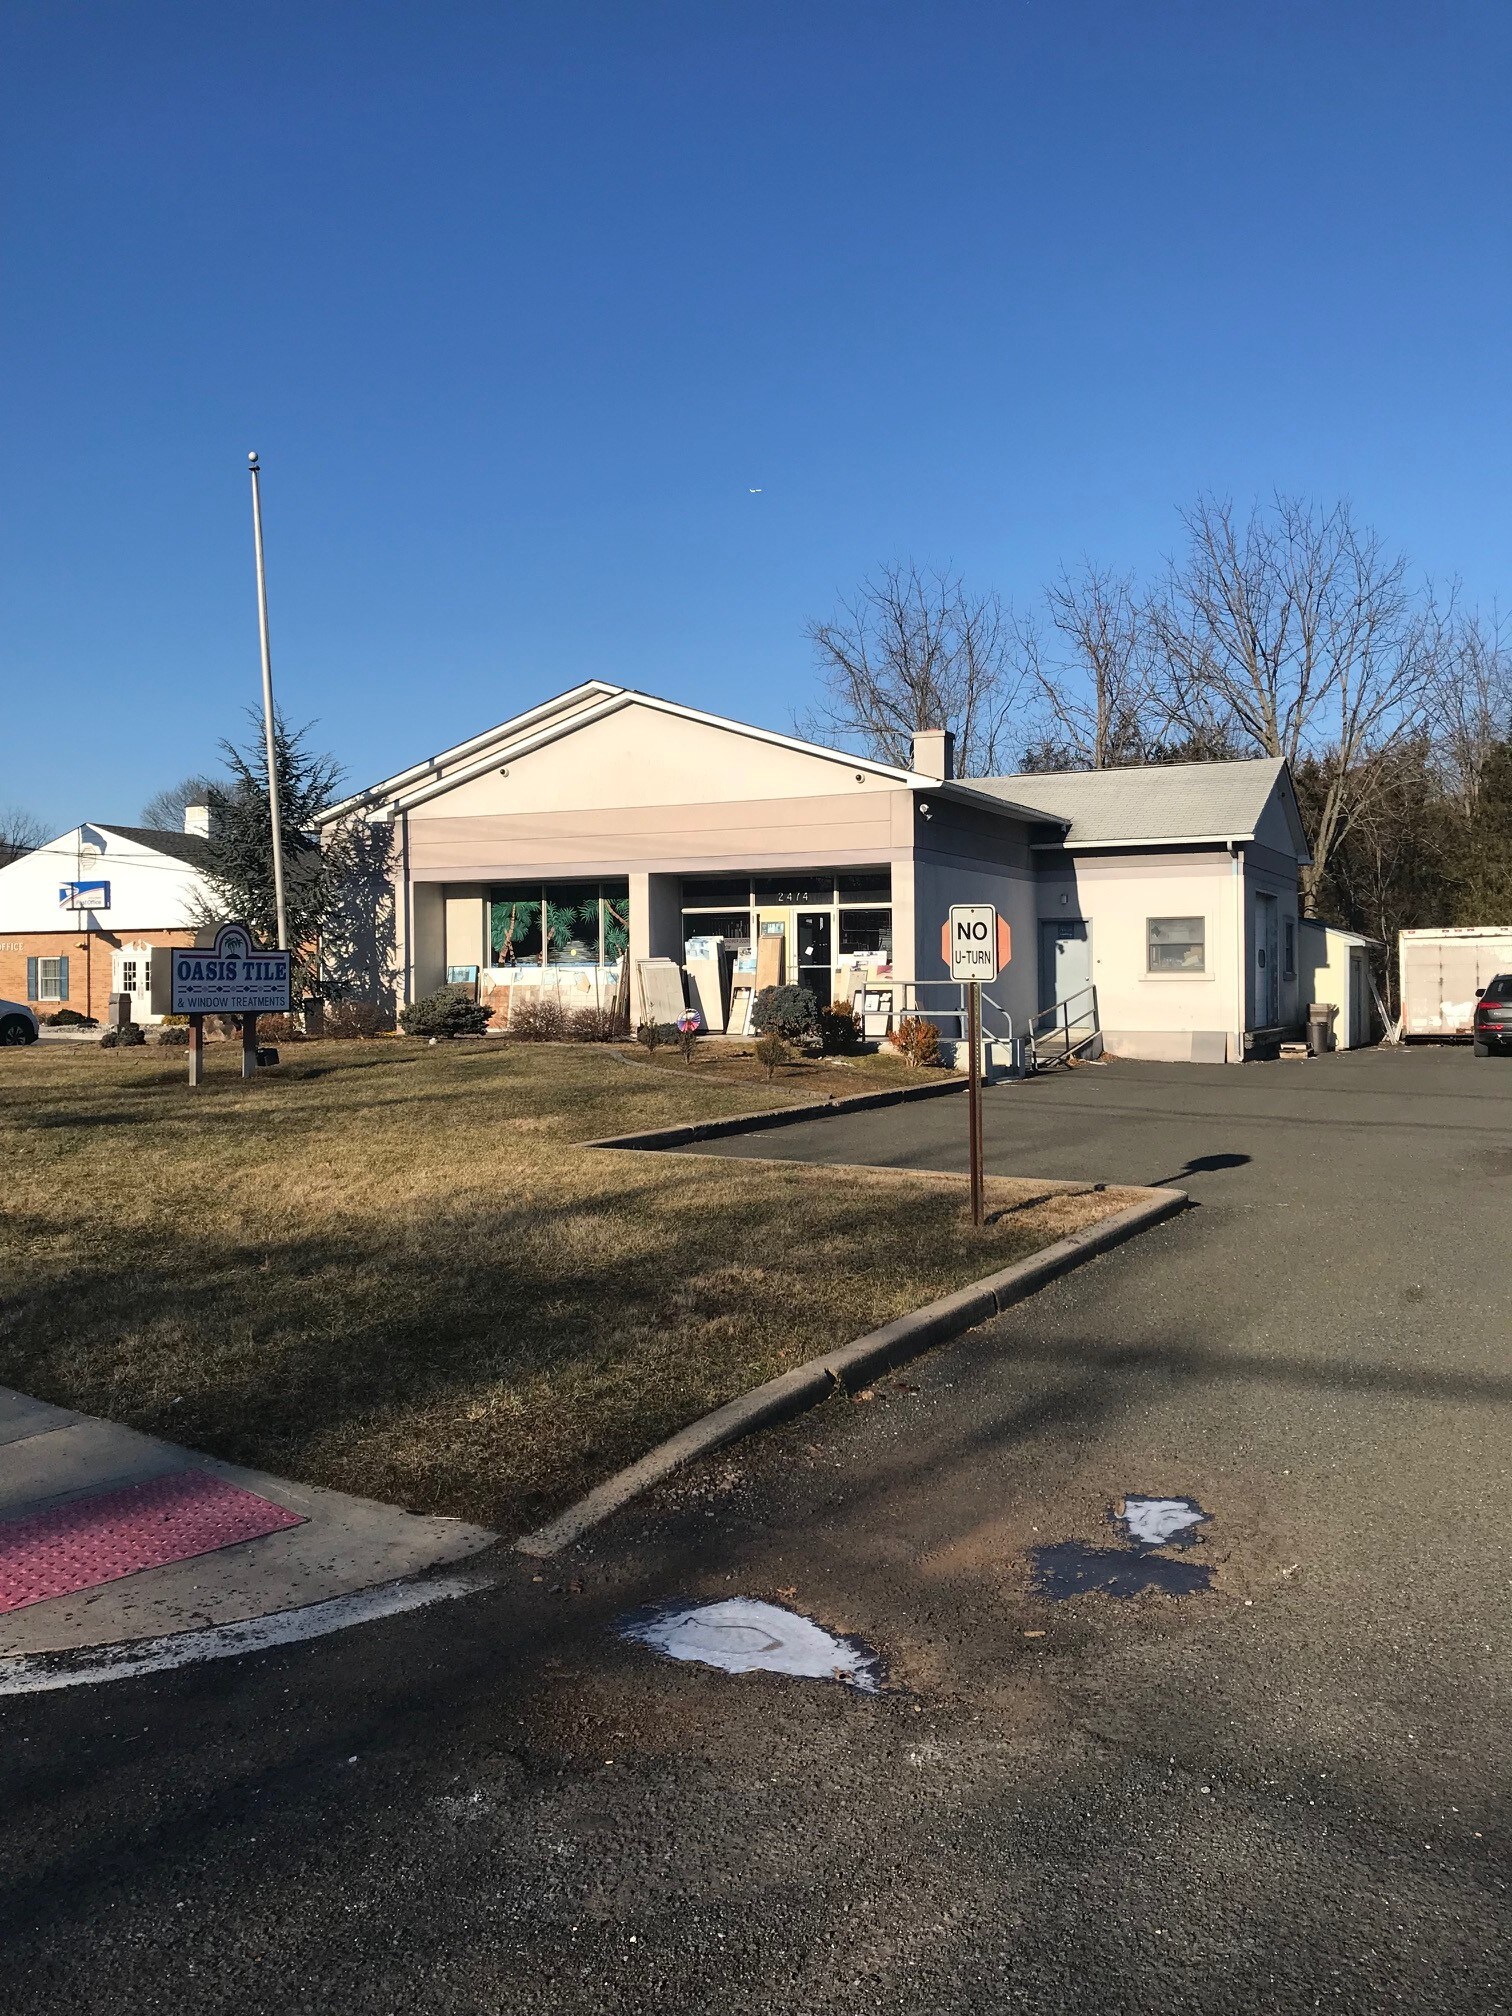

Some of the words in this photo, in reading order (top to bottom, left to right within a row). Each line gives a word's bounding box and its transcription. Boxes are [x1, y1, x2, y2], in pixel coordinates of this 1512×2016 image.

[957, 921, 988, 941] NO
[955, 950, 991, 965] U-TURN
[177, 960, 237, 981] OASIS
[242, 962, 287, 981] TILE
[177, 997, 185, 1008] &
[188, 997, 228, 1008] WINDOW
[231, 996, 286, 1007] TREATMENTS
